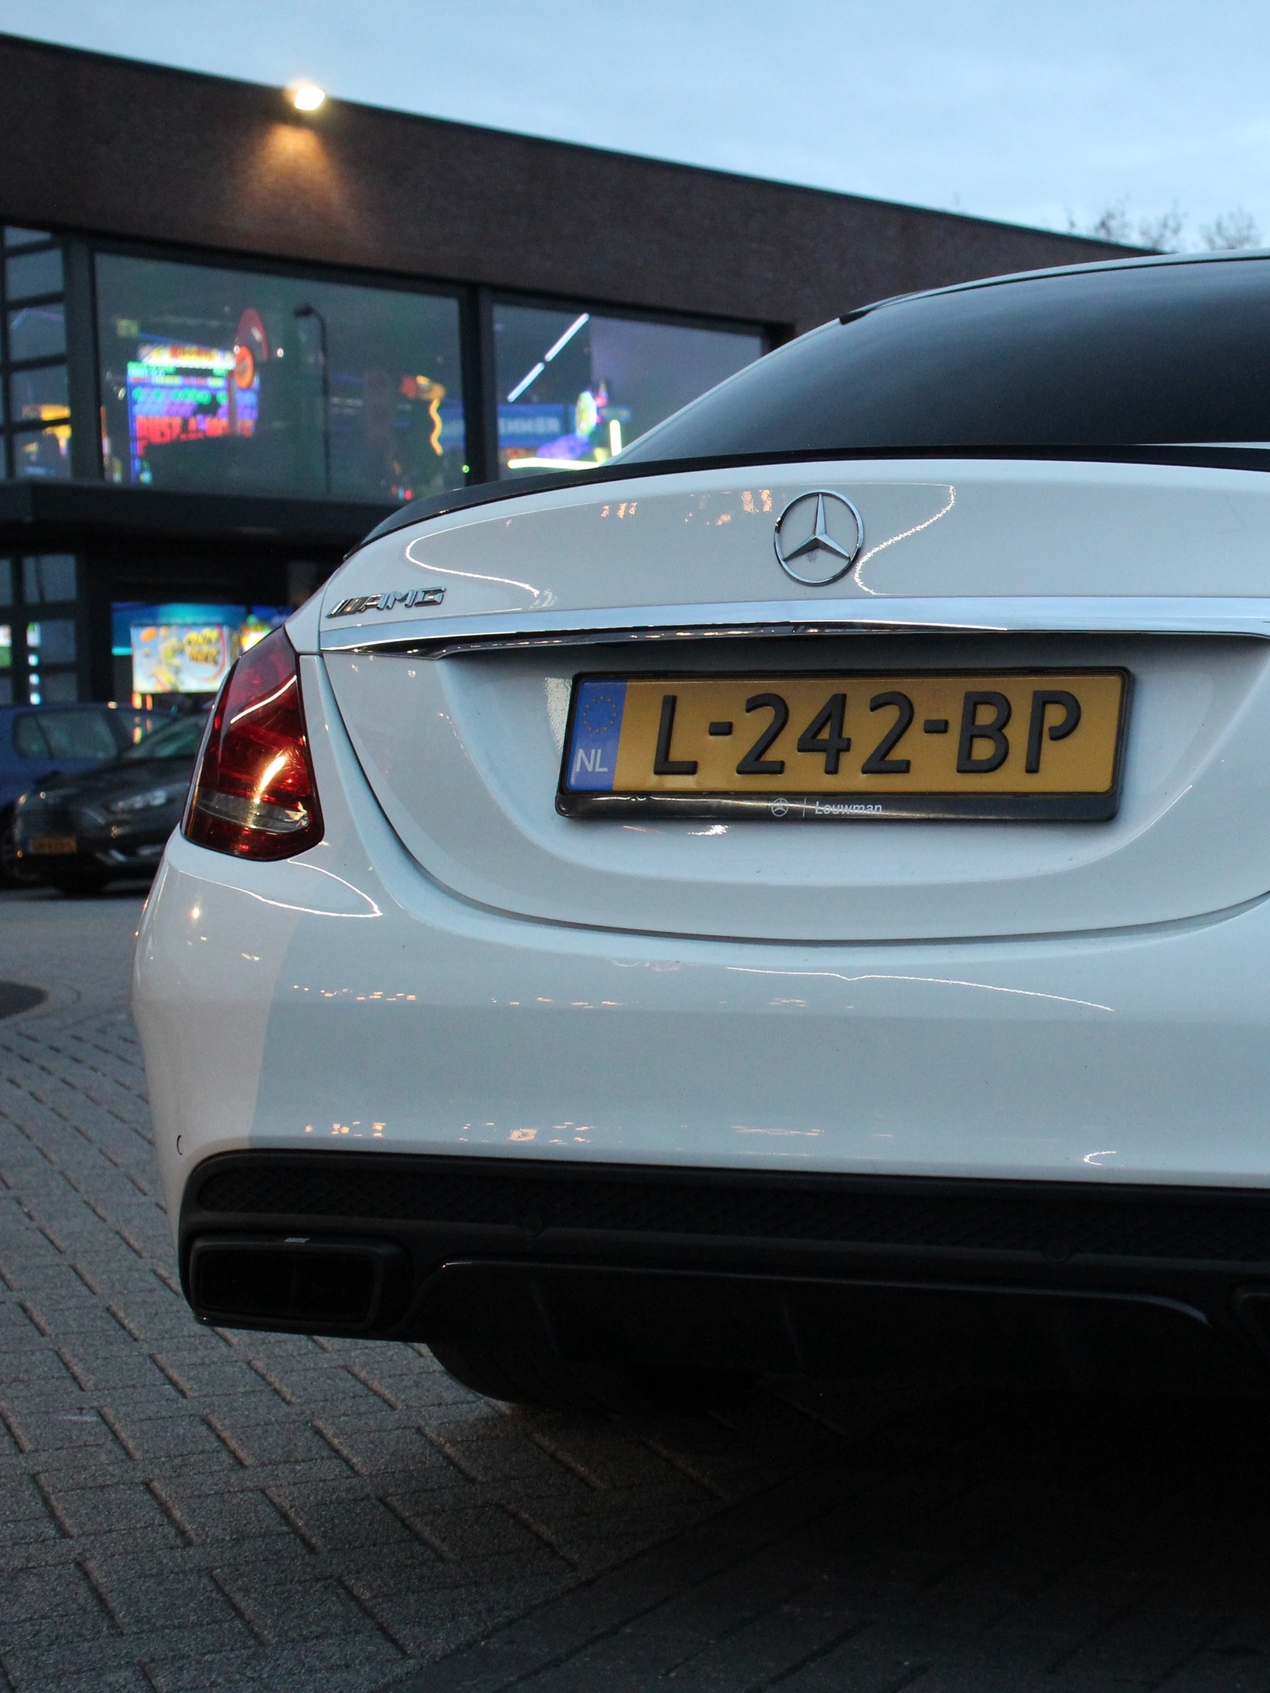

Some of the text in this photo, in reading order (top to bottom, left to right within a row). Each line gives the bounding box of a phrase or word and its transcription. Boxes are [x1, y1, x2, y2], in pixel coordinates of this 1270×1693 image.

[354, 587, 447, 613] AMG
[653, 690, 1082, 776] L-242-BP
[576, 748, 609, 773] NL
[815, 801, 882, 815] Louwman
